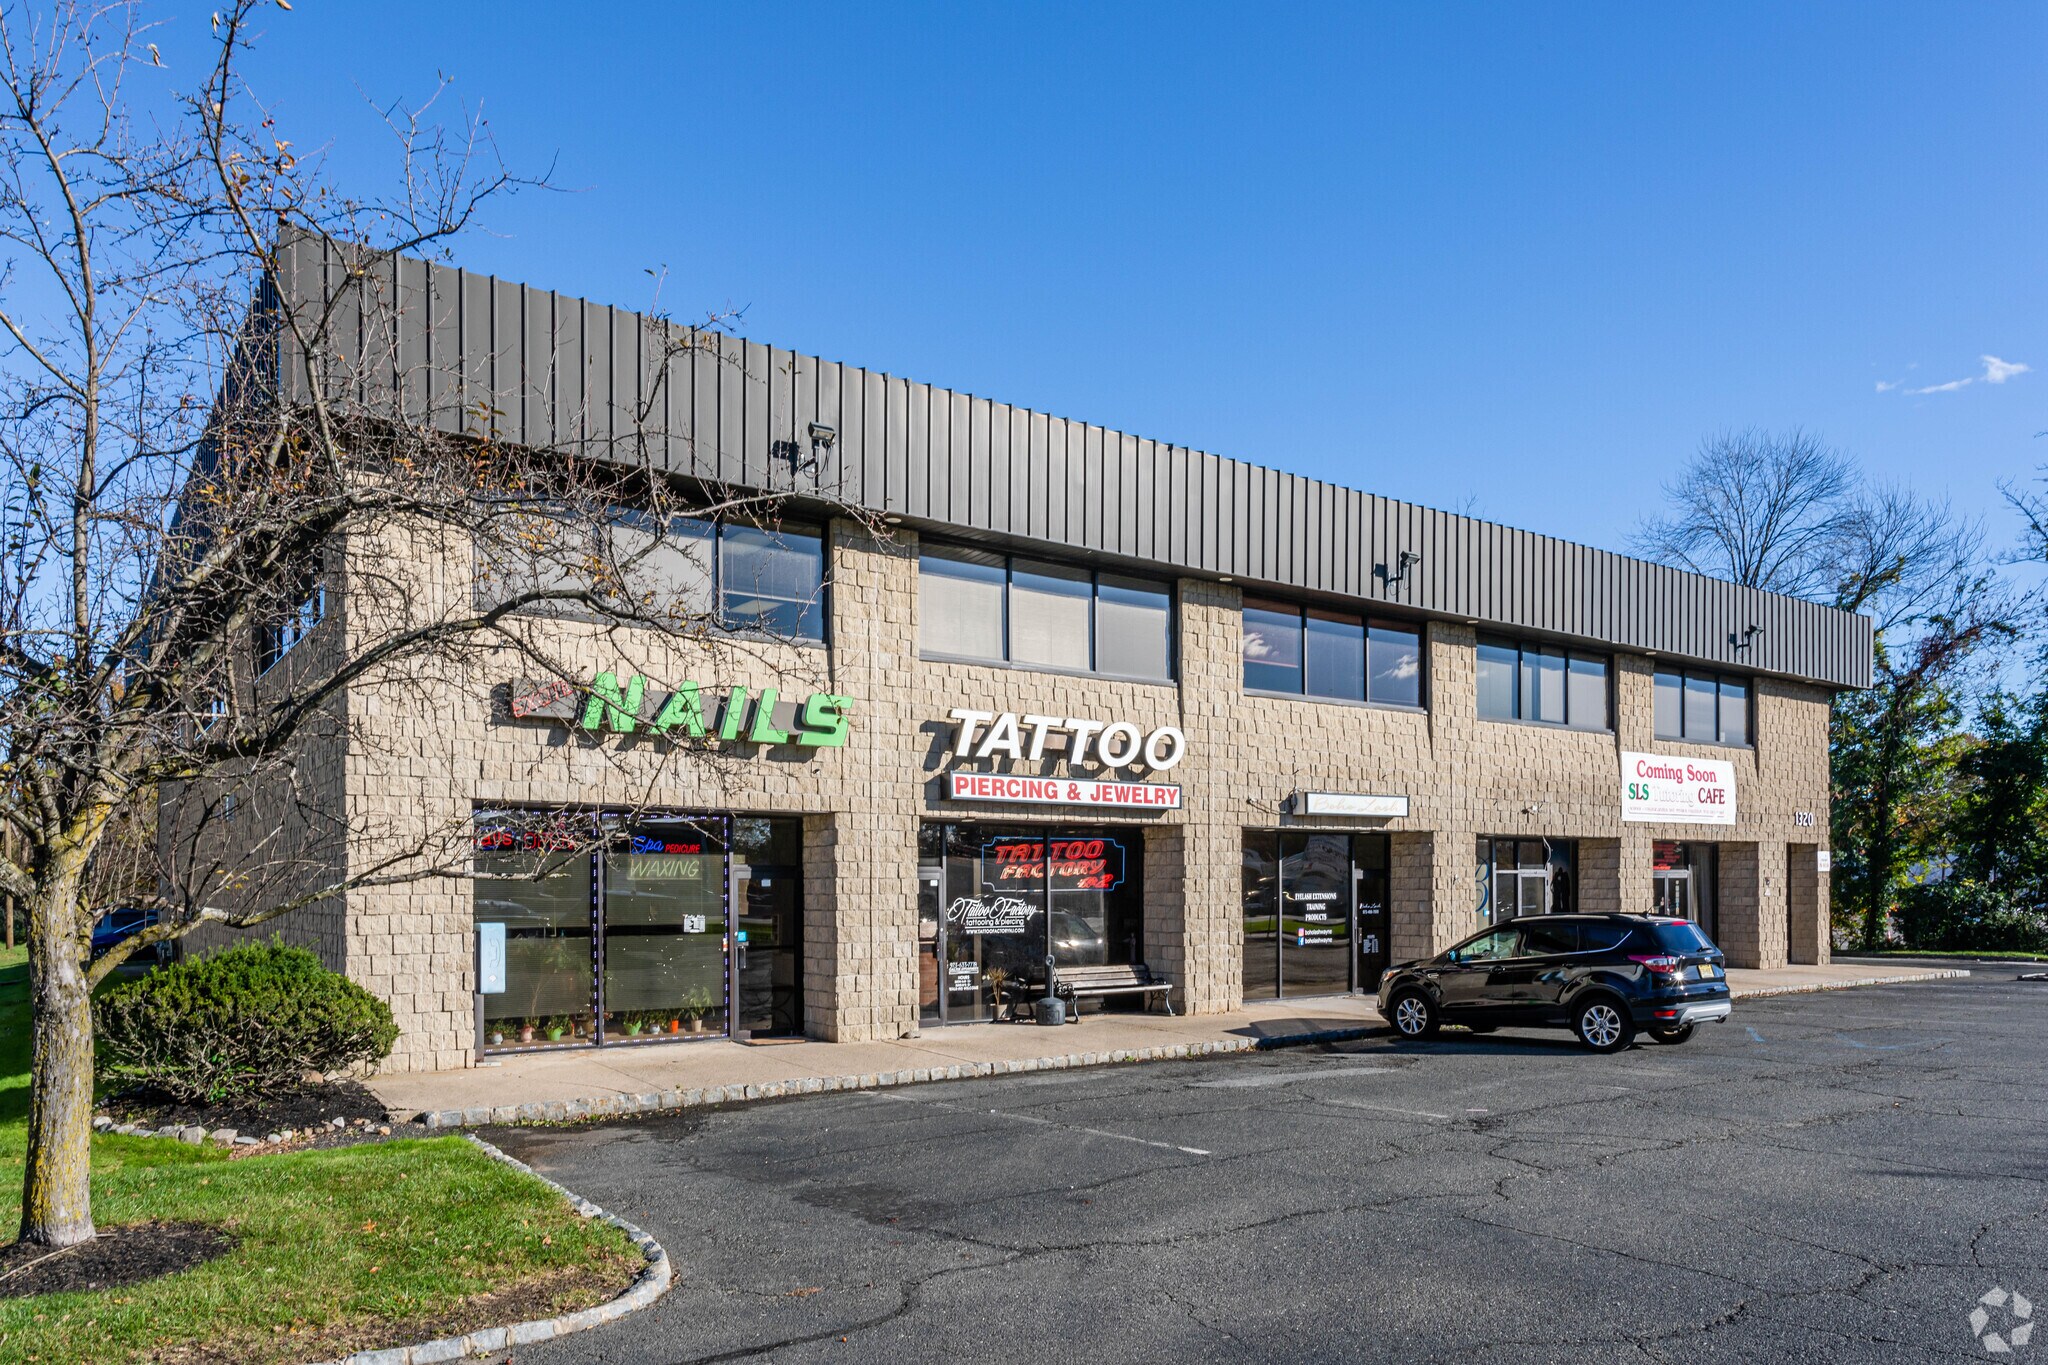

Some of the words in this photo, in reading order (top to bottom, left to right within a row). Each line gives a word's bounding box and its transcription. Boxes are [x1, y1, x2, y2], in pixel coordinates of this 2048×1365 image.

[582, 672, 854, 747] NAILS
[950, 709, 1185, 771] TATTOO
[1636, 760, 1683, 784] Coming
[1687, 764, 1717, 783] Soon
[955, 776, 1058, 800] PIERCING
[1067, 783, 1081, 800] &
[1090, 784, 1178, 805] JEWELRY
[1628, 782, 1650, 801] SLS
[1698, 787, 1726, 805] CAFE
[1795, 811, 1814, 826] 1320
[631, 836, 665, 855] Spa
[665, 843, 701, 854] PEDICURE
[995, 840, 1104, 865] TATTOO
[629, 860, 700, 877] WAXING
[1000, 859, 1107, 880] FACTORY
[1294, 892, 1312, 900] EYELASH
[1313, 892, 1337, 900] EXTENSIONS
[947, 897, 990, 924] Tattoo
[989, 896, 1037, 921] Factory
[1305, 913, 1327, 921] PRODUCTS
[1306, 903, 1326, 911] TRAINING
[966, 919, 994, 927] tattooing
[1001, 918, 1024, 926] piercing
